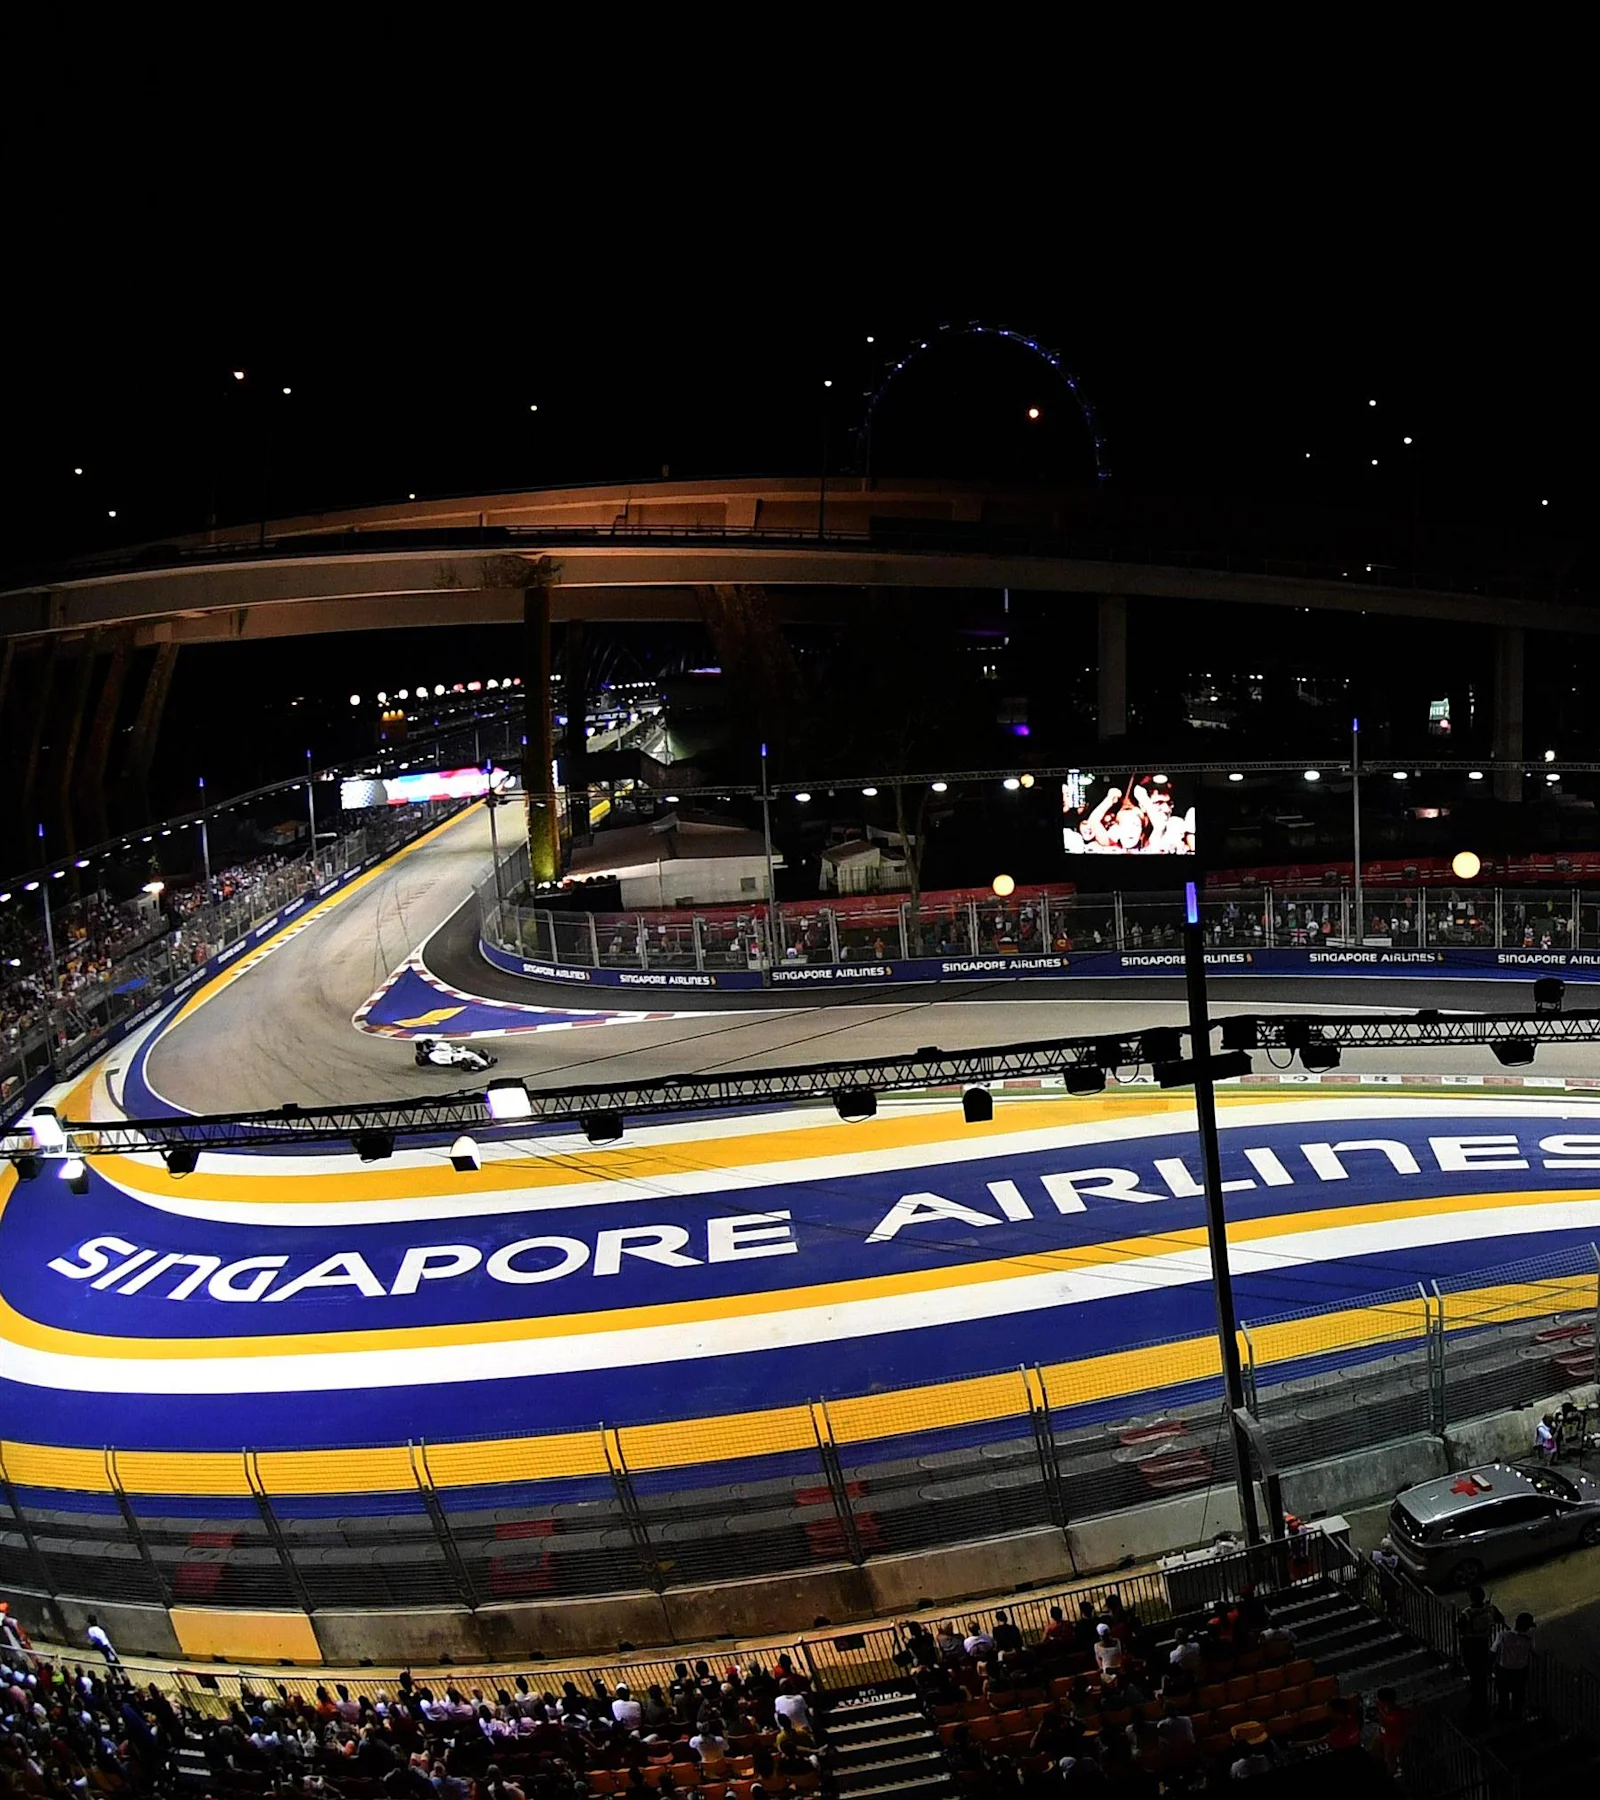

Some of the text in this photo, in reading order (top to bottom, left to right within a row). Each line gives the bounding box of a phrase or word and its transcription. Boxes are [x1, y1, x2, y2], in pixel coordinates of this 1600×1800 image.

[1120, 953, 1245, 966] SINGAPORE RLINES
[1309, 952, 1436, 963] SINGAPORE AIRLINES
[1497, 953, 1567, 965] SINGAPORE
[941, 958, 1062, 973] SINGAPORE AIRLINES
[619, 974, 710, 986] SINGAPORE AIRLINES
[771, 966, 885, 981] SINGAPORE AIRLINES
[48, 1210, 799, 1302] SINGAPORE
